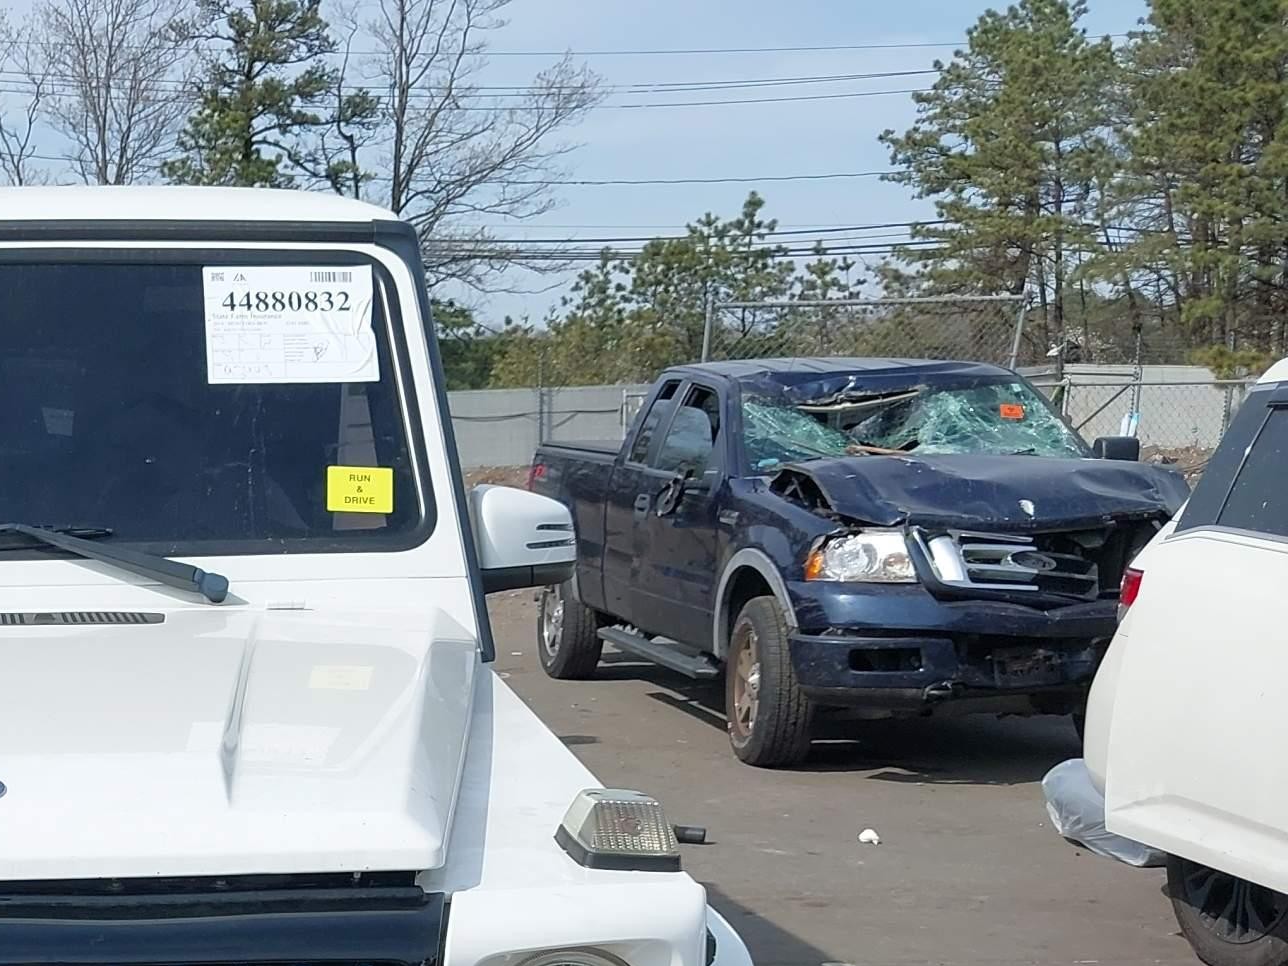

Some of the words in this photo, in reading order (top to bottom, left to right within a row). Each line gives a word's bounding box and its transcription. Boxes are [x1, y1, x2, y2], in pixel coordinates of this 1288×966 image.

[222, 291, 351, 312] 44880832
[348, 473, 371, 483] RUN
[356, 485, 363, 493] &
[344, 496, 376, 505] DRIVE
